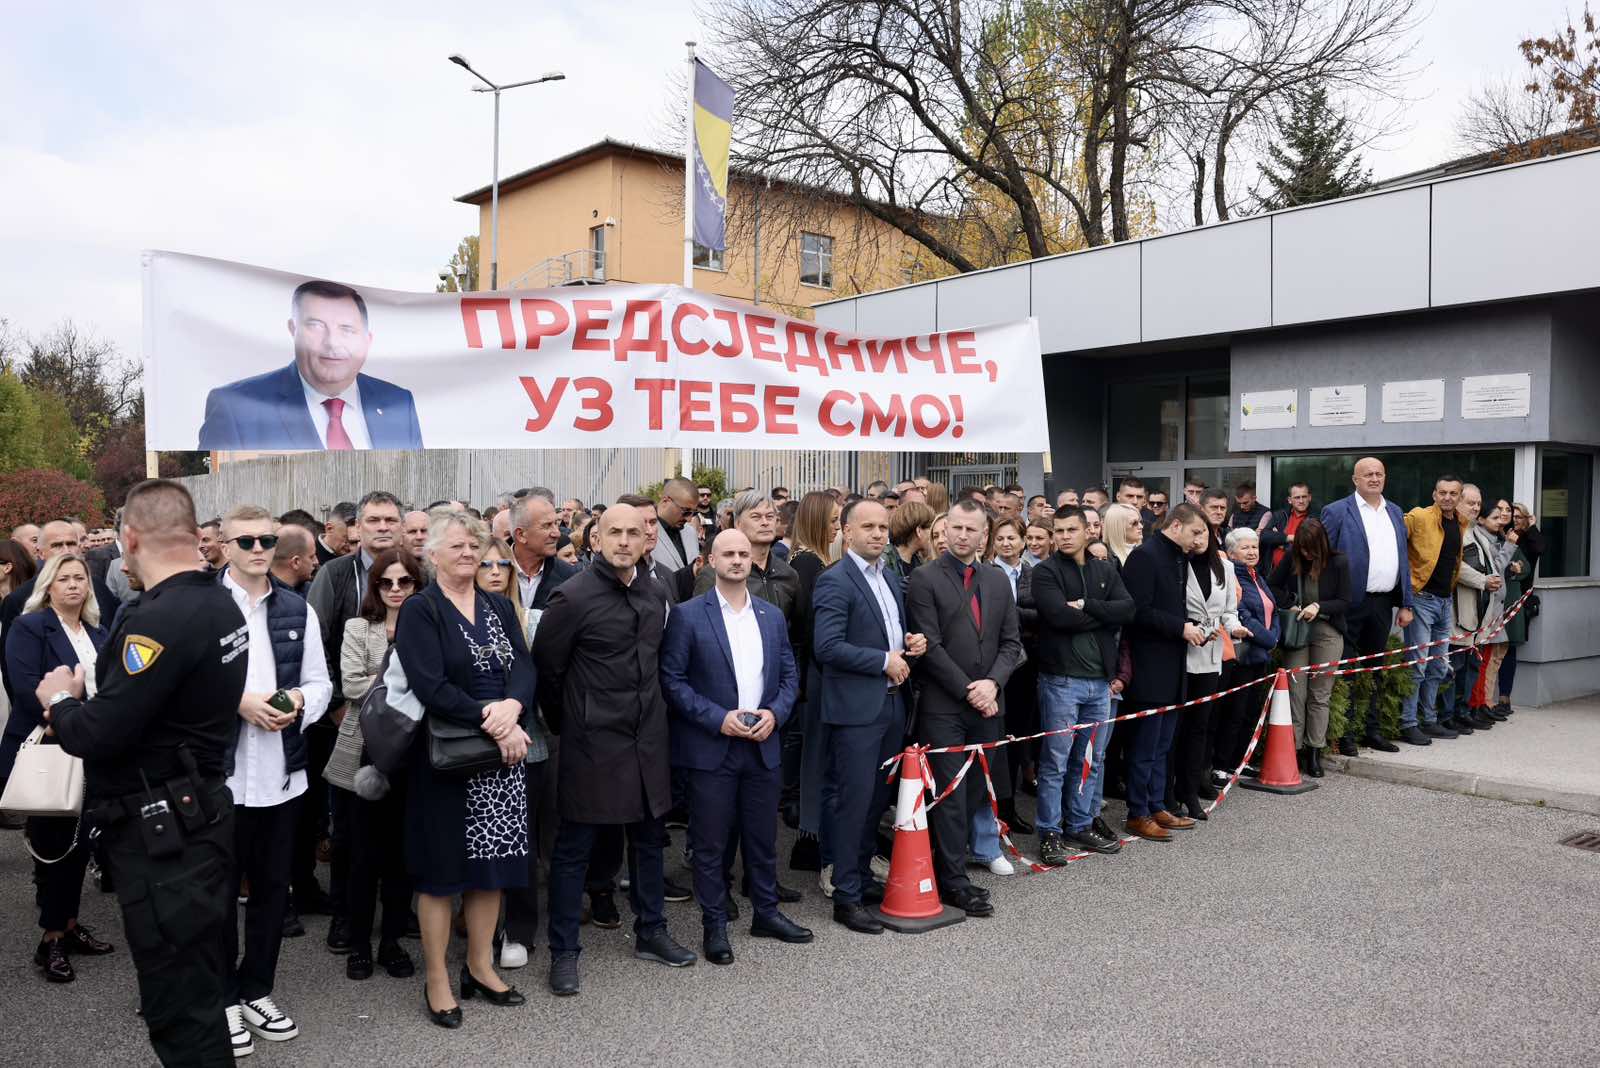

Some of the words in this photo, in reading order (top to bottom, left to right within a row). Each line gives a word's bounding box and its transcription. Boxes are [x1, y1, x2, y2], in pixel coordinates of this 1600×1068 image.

[461, 297, 998, 382] ПРЕДСЈЕДНИЧЕ,
[518, 376, 614, 432] УЗ
[634, 377, 800, 434] ТЕБЕ
[817, 389, 965, 439] СМО!
